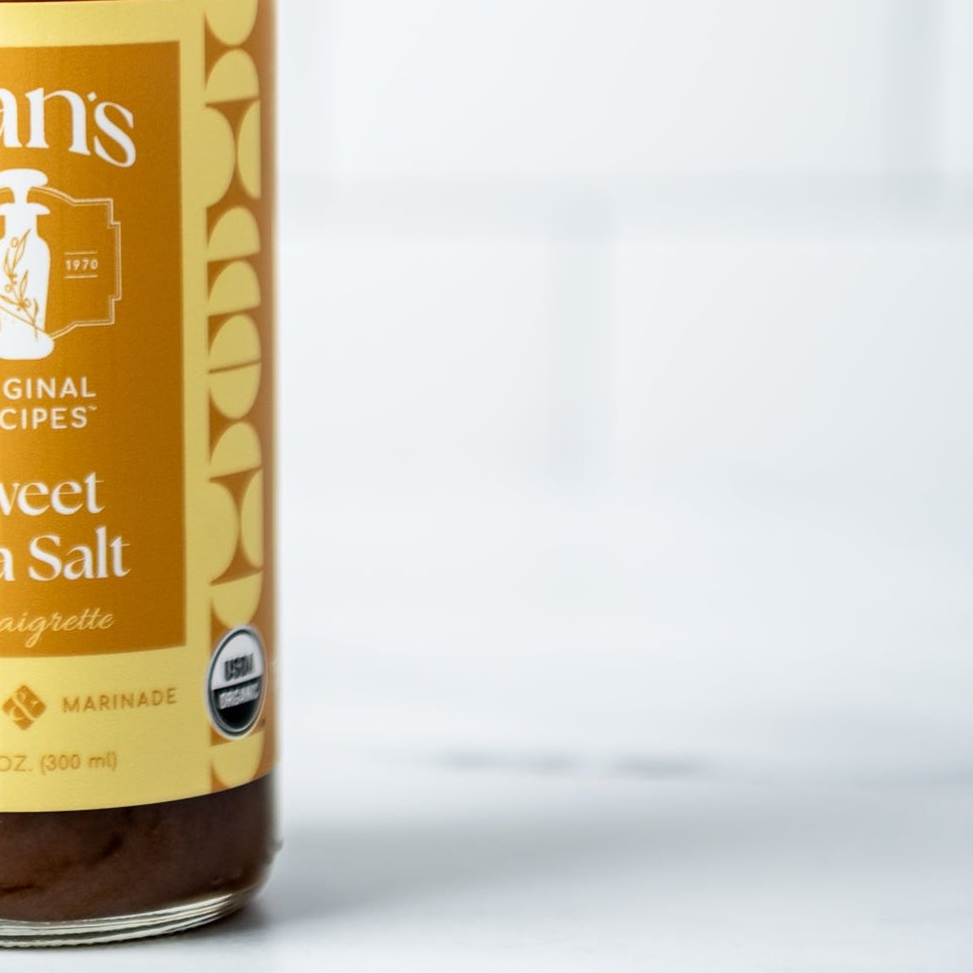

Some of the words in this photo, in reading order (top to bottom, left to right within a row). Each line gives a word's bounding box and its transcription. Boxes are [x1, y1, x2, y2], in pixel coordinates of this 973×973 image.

[65, 257, 99, 272] 1970
[28, 526, 132, 581] Salt
[62, 687, 178, 715] MARINADE
[40, 751, 83, 775] (300
[90, 750, 118, 773] ml)
